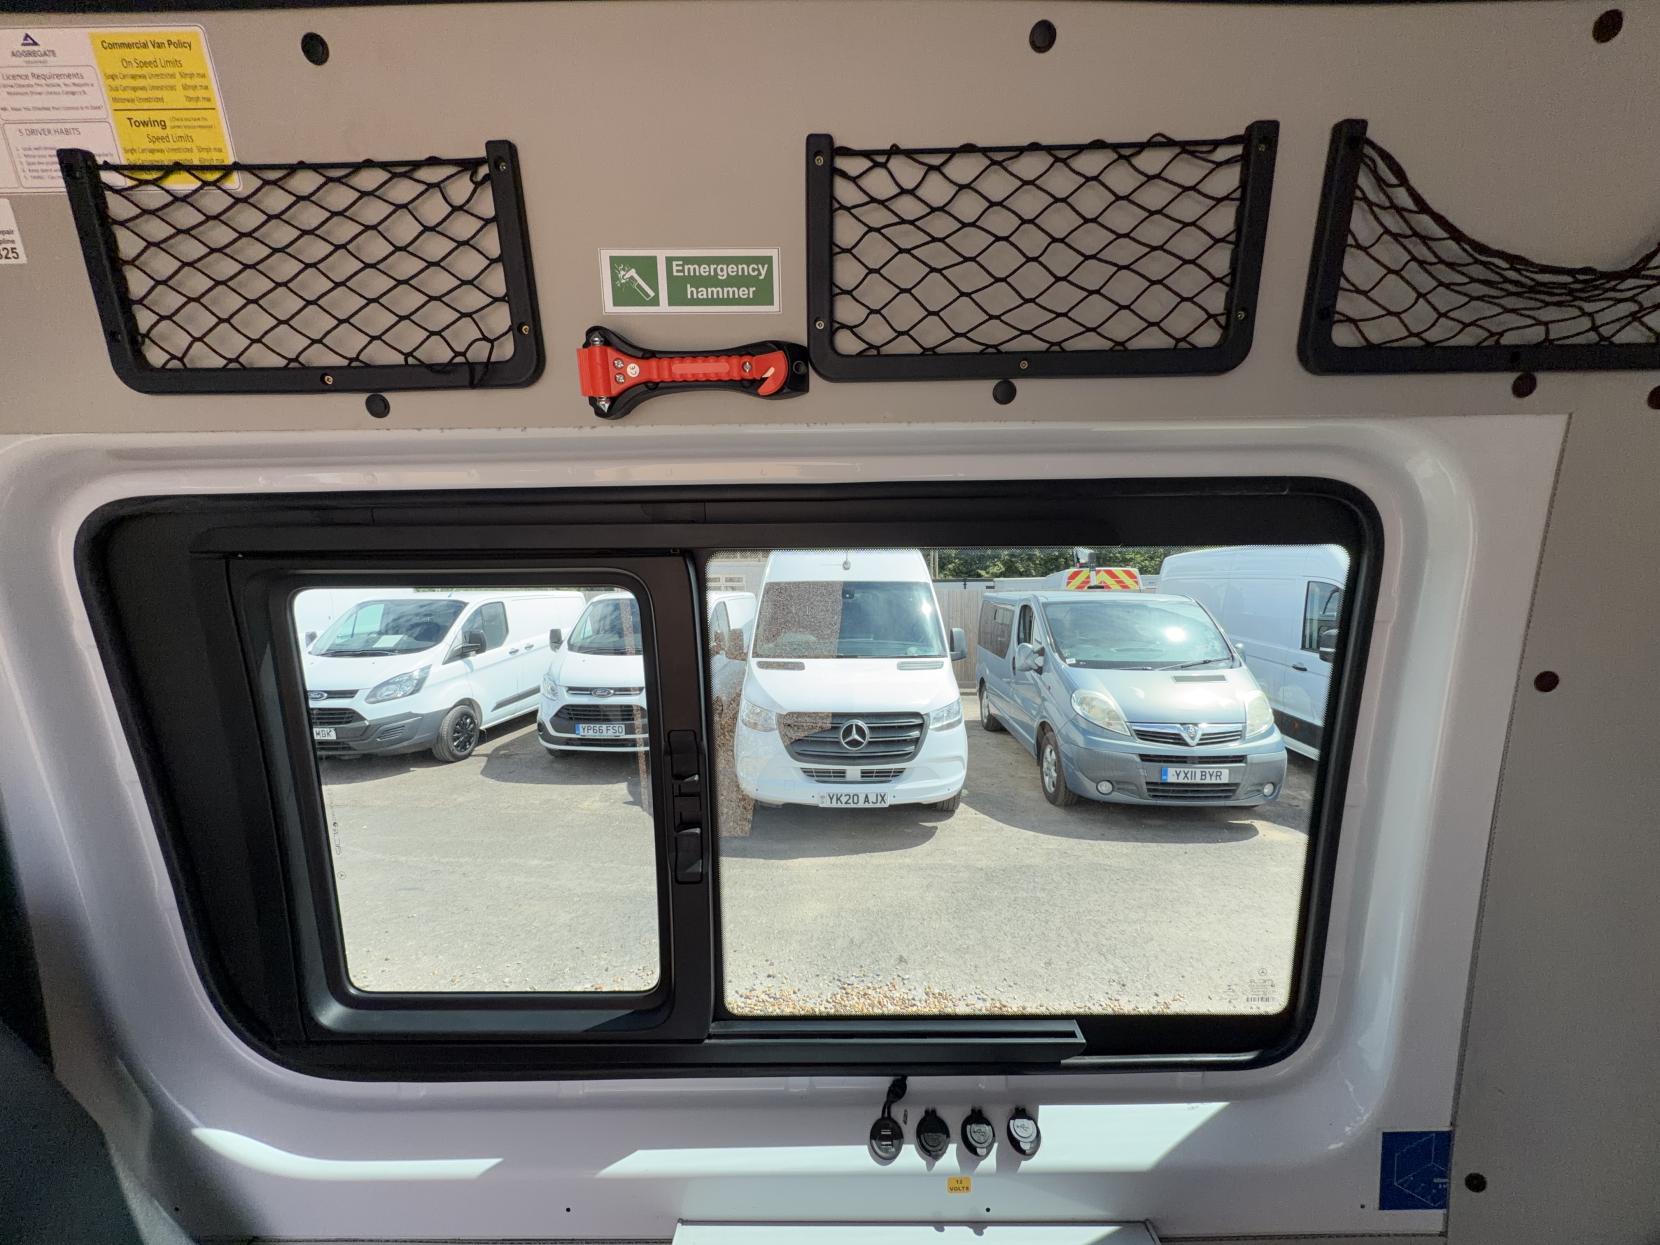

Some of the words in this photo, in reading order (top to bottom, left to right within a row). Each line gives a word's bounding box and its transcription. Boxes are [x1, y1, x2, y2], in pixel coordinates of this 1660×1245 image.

[100, 39, 149, 50] Commercial
[149, 39, 166, 50] Van
[167, 39, 192, 52] Policy
[11, 49, 57, 58] AGGREGATE
[121, 58, 132, 69] On
[134, 58, 159, 69] Speed
[159, 58, 183, 68] Limits
[31, 72, 84, 81] Requirements
[126, 117, 167, 130] Towing
[25, 128, 52, 136] DRIVER
[54, 127, 81, 136] HABITS
[146, 133, 171, 144] Speed
[171, 133, 194, 143] Limits
[672, 260, 768, 279] Emergency
[686, 284, 756, 299] hammer
[581, 725, 604, 734] YP66
[1174, 769, 1197, 781] YX11
[1200, 770, 1223, 781] BYR
[827, 793, 860, 805] YK20
[863, 793, 887, 805] AJX
